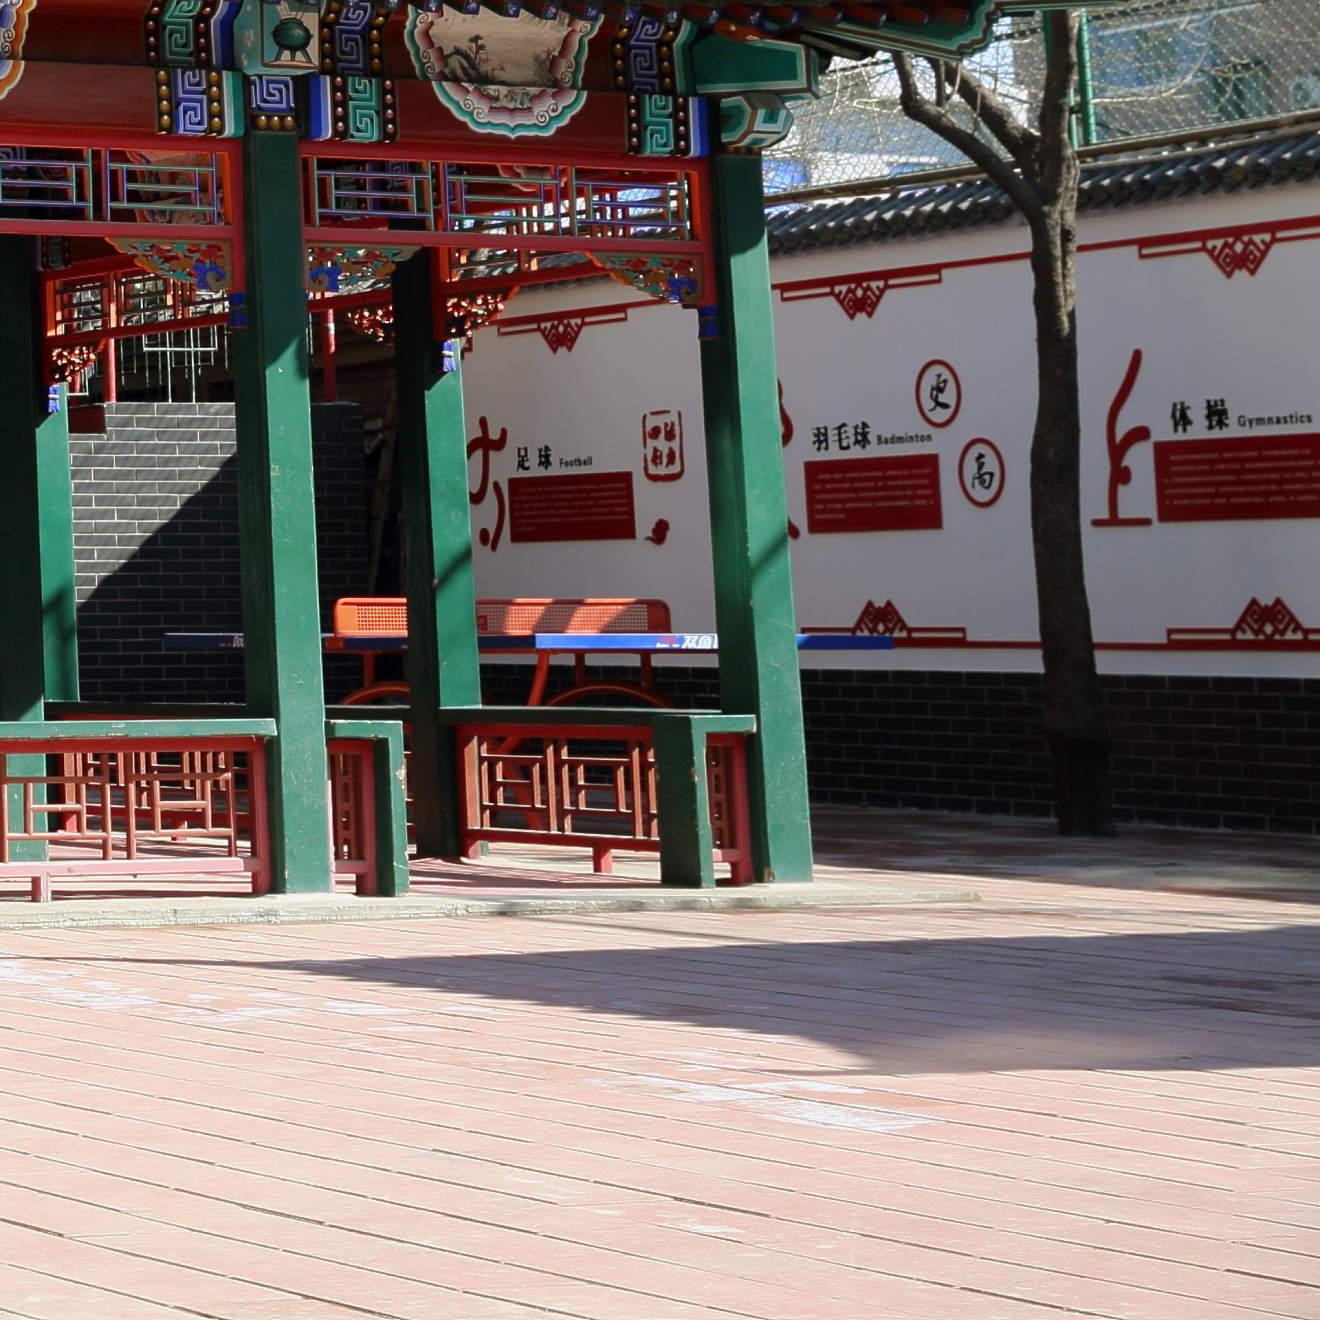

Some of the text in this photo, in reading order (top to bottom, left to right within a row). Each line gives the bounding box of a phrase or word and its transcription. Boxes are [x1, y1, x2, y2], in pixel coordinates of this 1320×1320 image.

[927, 372, 952, 412] 更
[1171, 398, 1313, 434] 体操 Gymnastics
[811, 421, 933, 452] 羽毛球 Badminton
[516, 445, 593, 472] 足球 Football
[971, 452, 995, 491] 高
